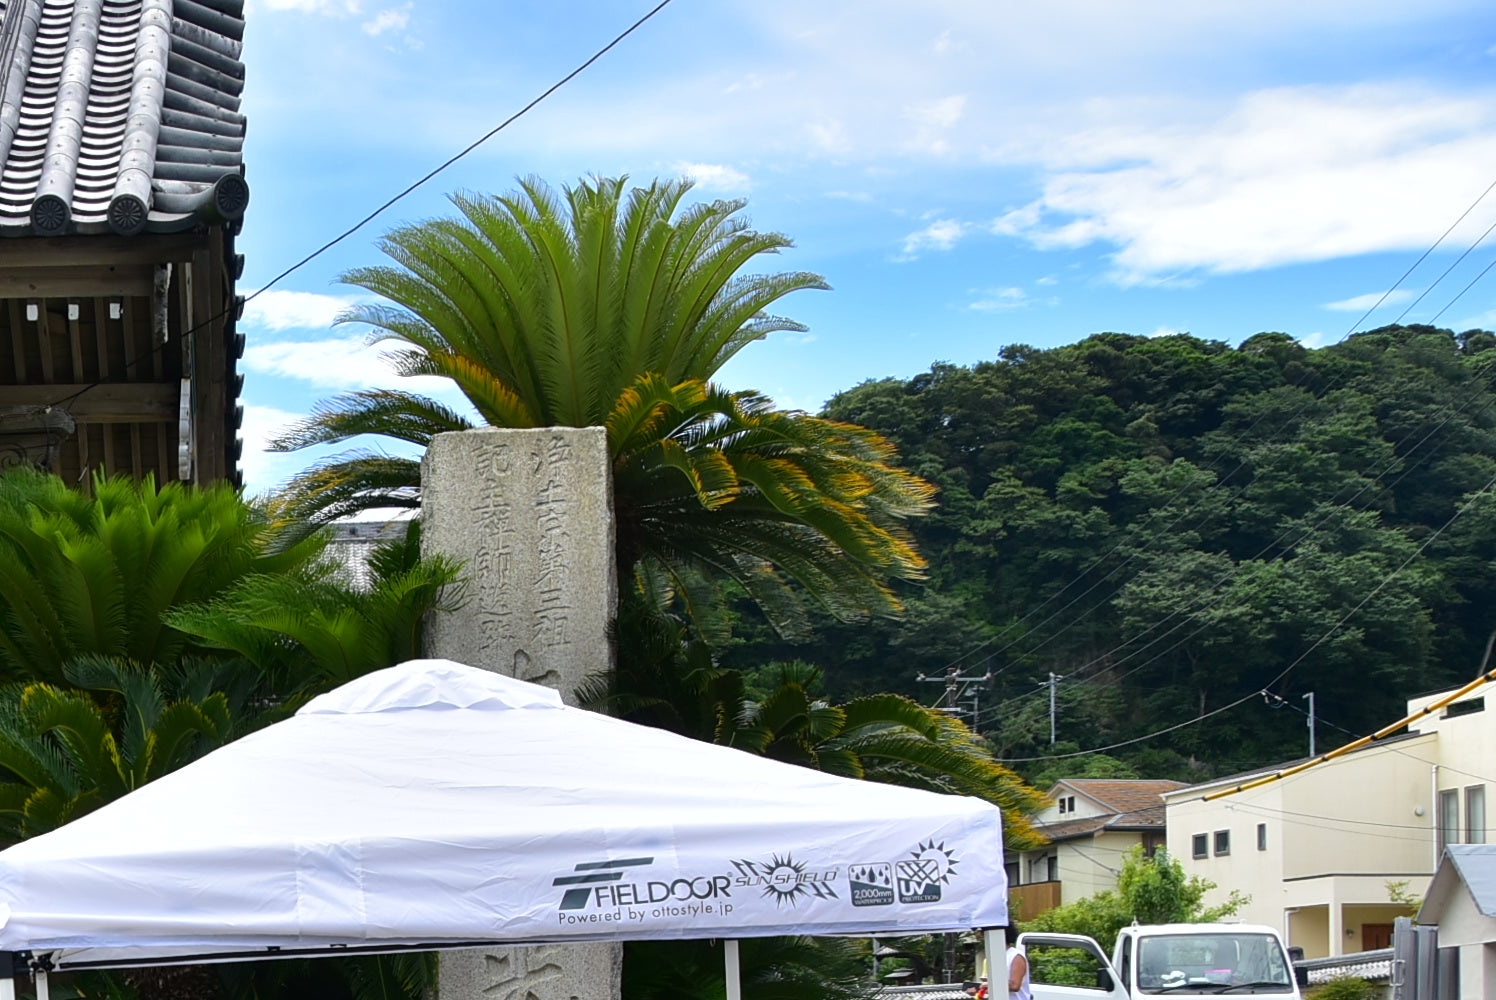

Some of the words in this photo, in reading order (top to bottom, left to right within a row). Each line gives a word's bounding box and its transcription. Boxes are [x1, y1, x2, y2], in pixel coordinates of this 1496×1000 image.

[734, 874, 772, 887] SUN
[773, 871, 837, 885] SHIELD
[594, 876, 732, 908] FIELDOOR
[853, 888, 892, 899] 2,000mm
[899, 880, 928, 896] UV
[558, 907, 622, 925] Powered
[628, 906, 646, 922] by
[652, 900, 734, 918] ottostyle.jp
